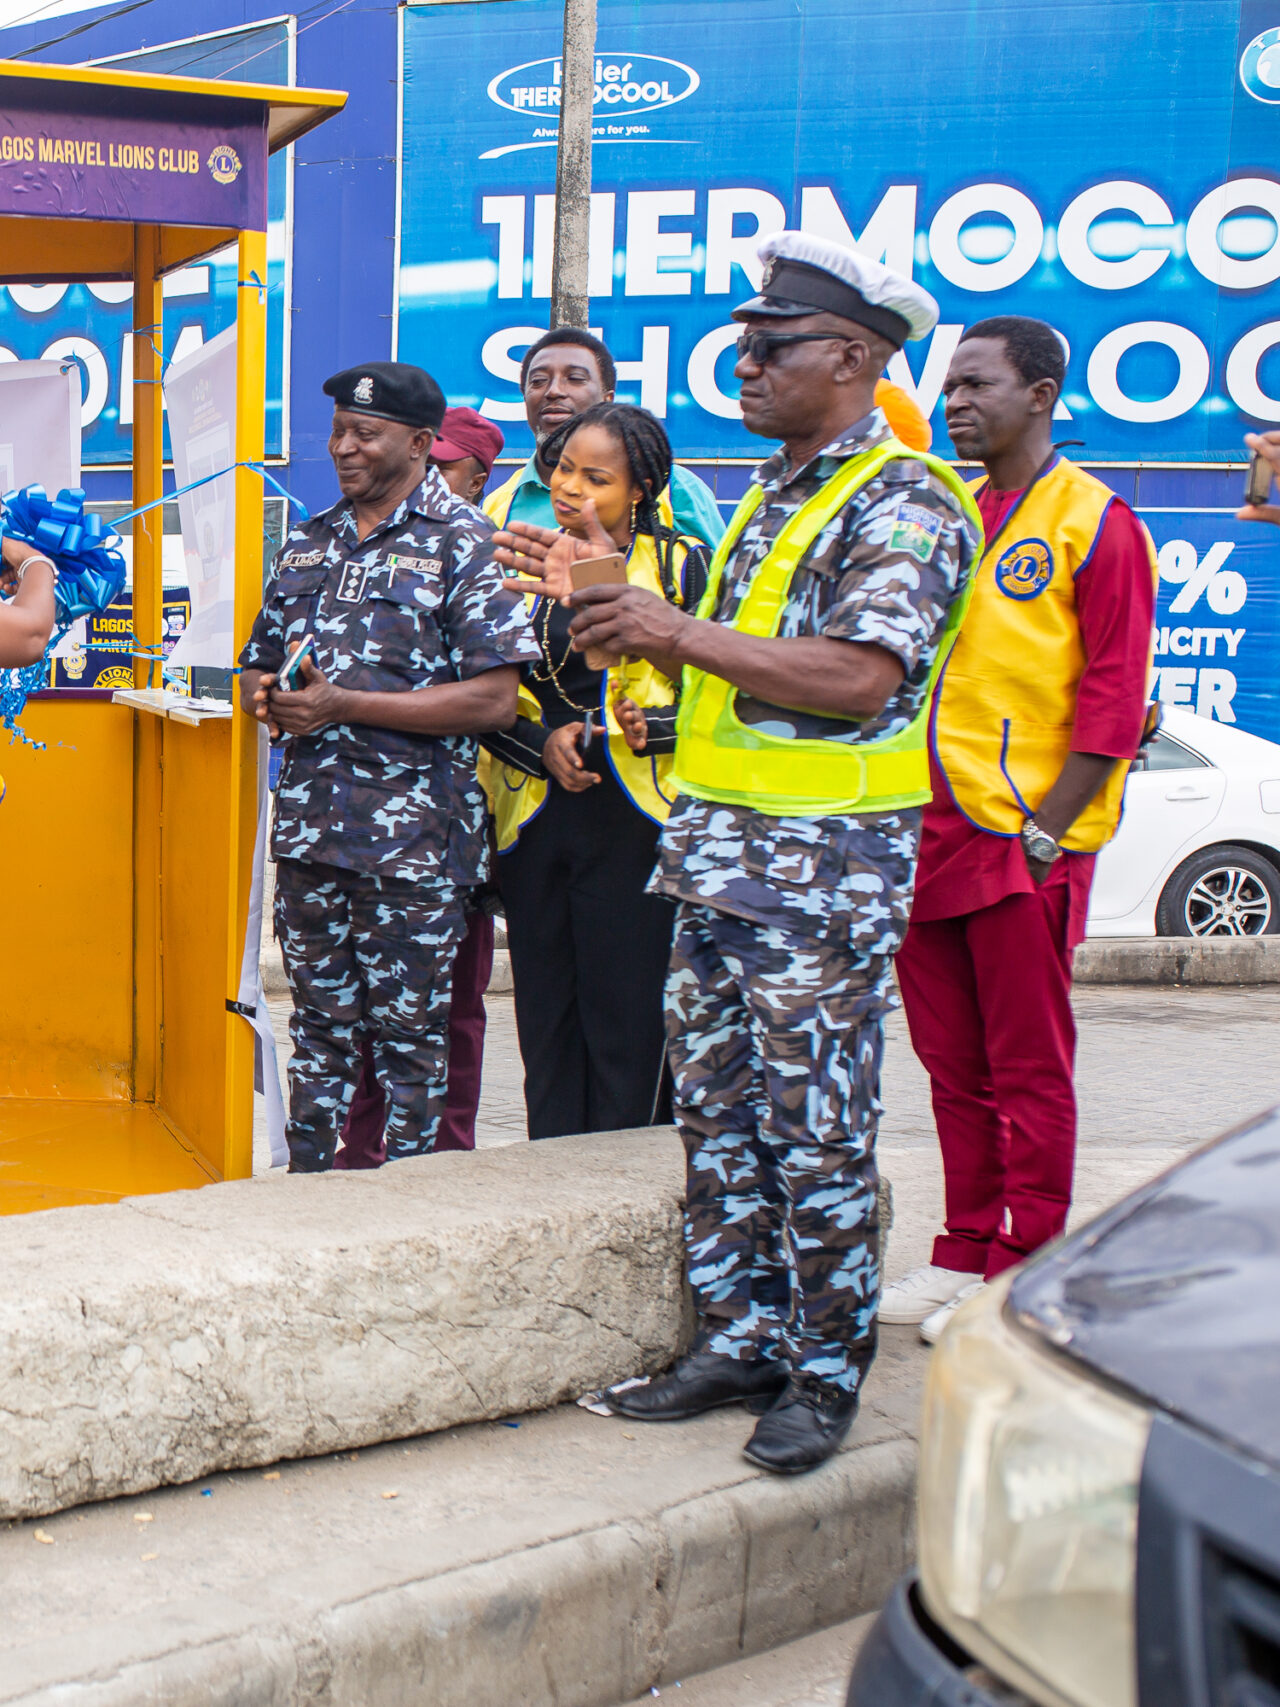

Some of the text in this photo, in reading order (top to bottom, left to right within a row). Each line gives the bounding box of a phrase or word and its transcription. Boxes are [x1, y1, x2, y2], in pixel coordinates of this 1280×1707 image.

[607, 125, 624, 135] for
[625, 124, 651, 137] you.
[38, 138, 106, 166] MARVEL
[109, 143, 155, 170] LIONS
[158, 148, 200, 174] CLUB
[93, 617, 133, 633] LAGOS
